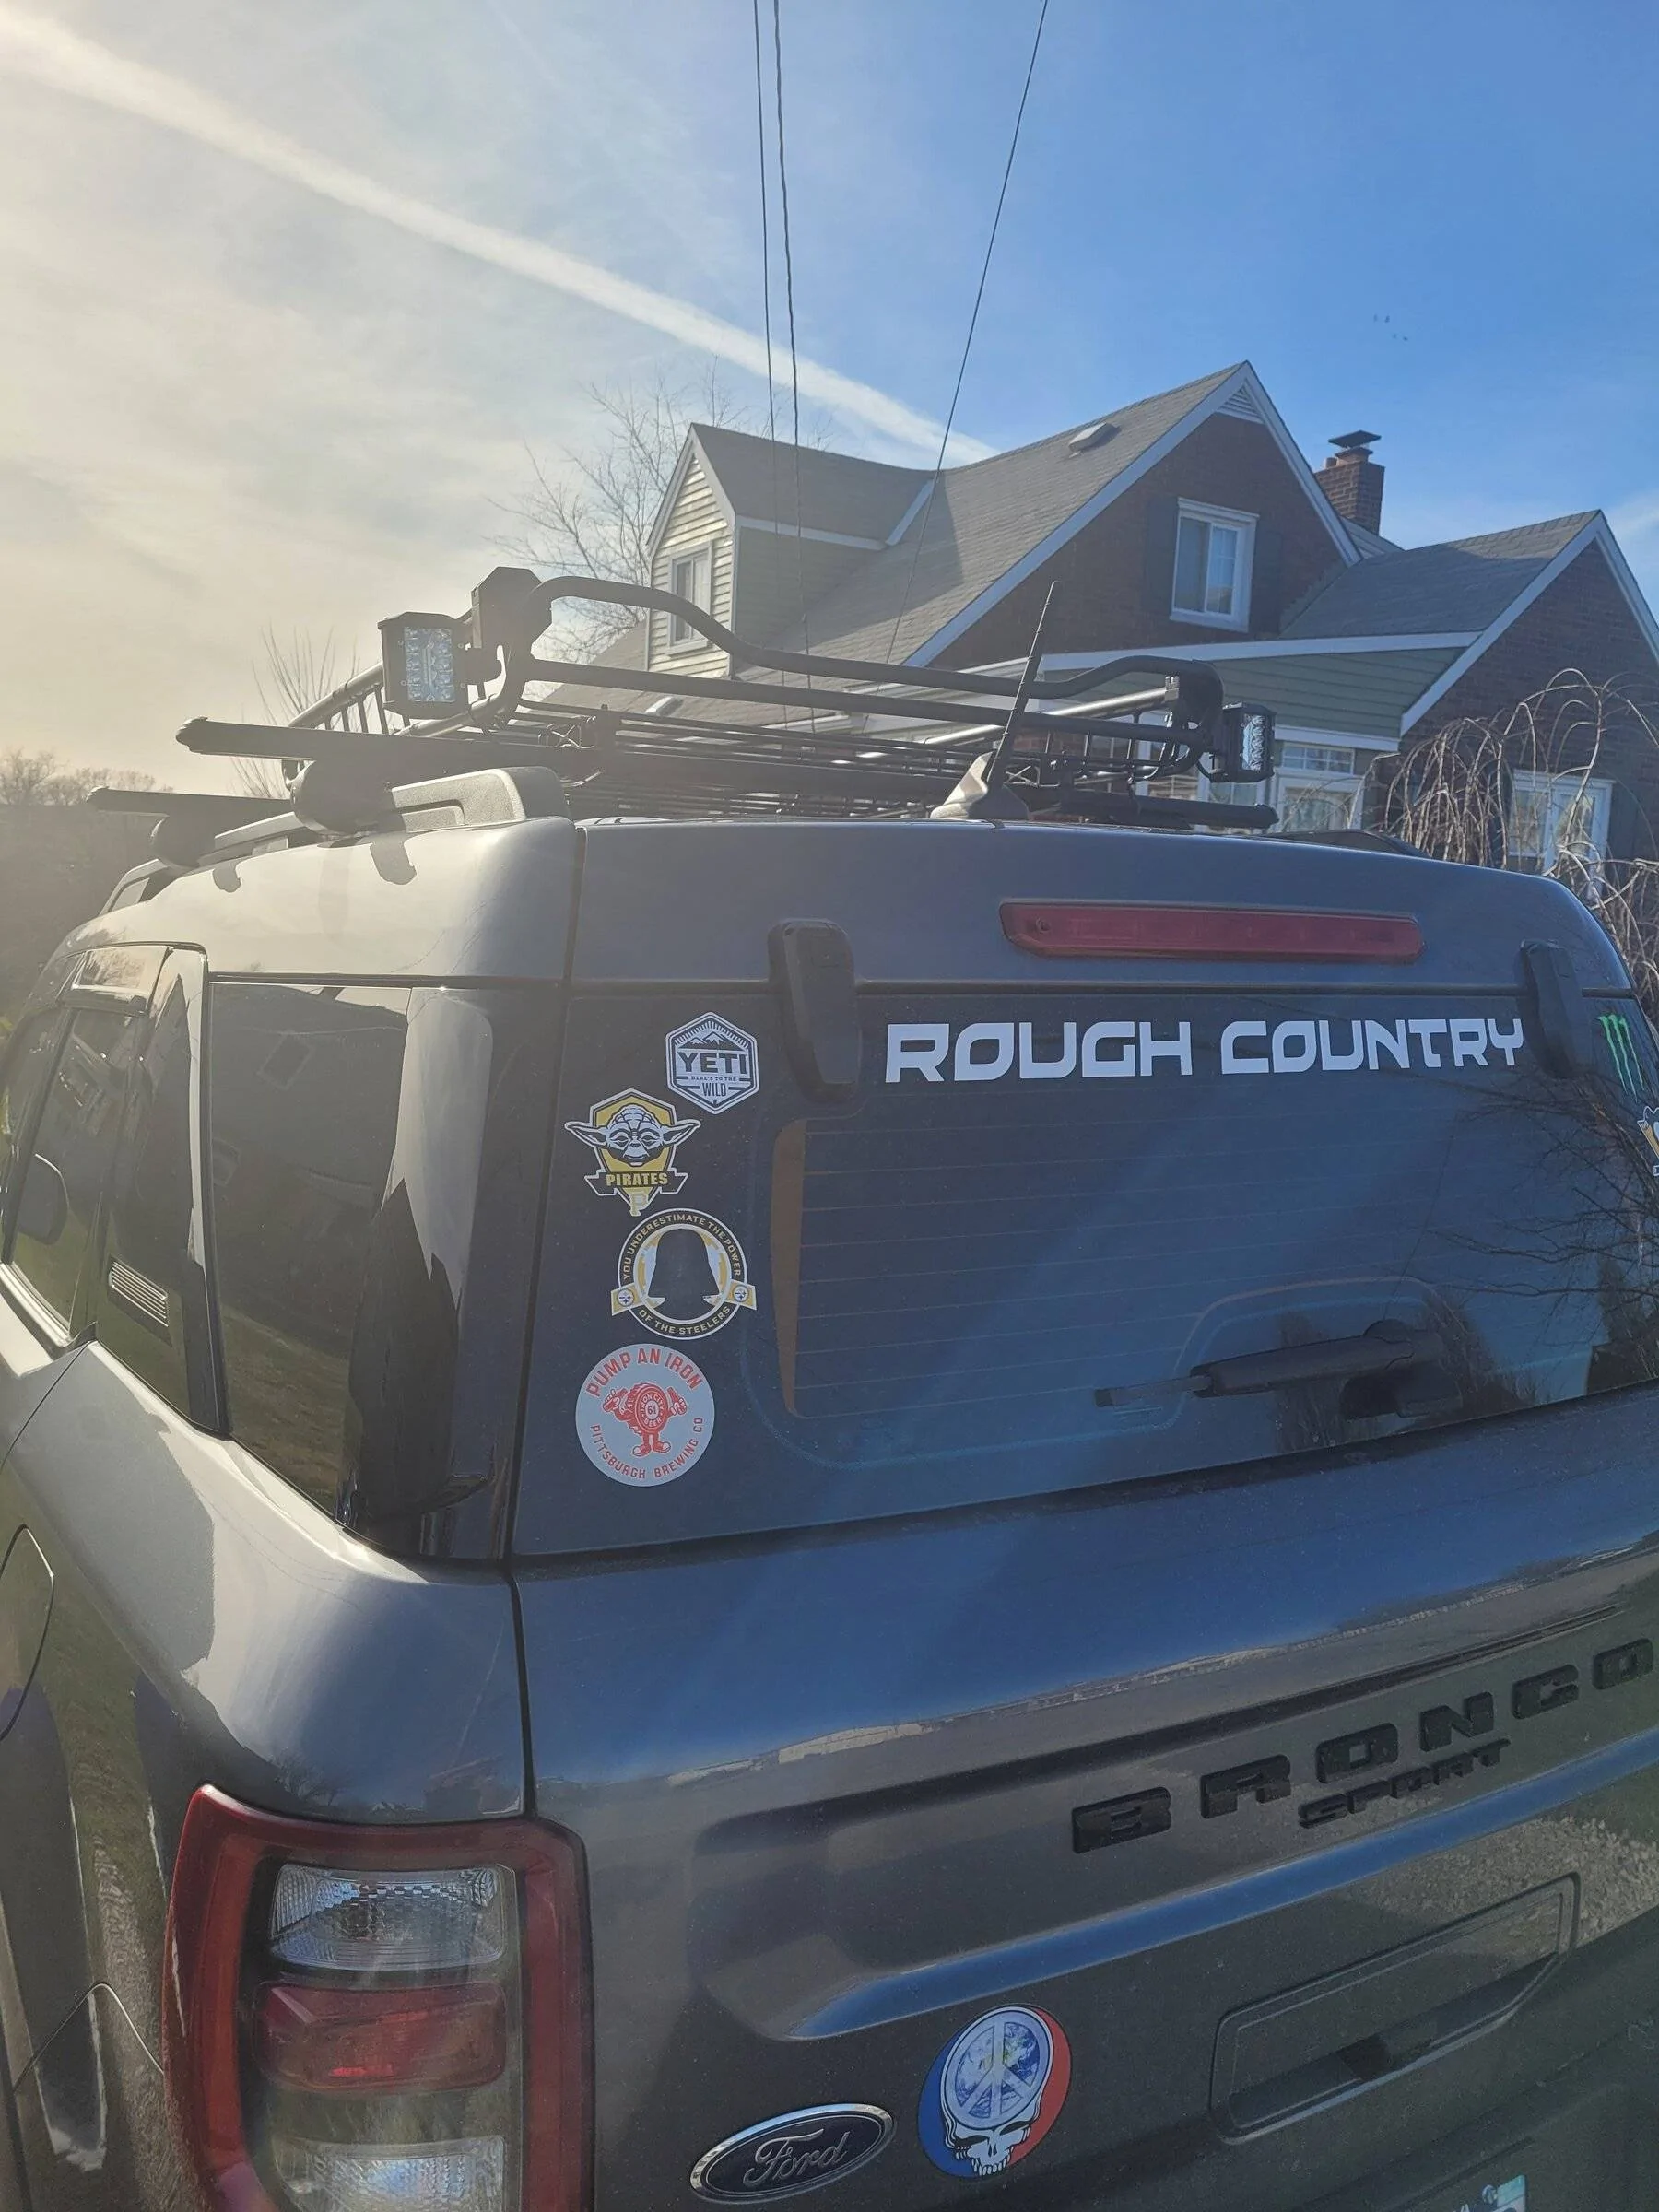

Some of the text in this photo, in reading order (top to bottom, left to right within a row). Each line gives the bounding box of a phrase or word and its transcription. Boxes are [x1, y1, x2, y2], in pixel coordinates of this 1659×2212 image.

[677, 1051, 748, 1075] YETI
[885, 1018, 1524, 1083] ROUGH COUNTRY
[702, 1082, 727, 1097] WILD
[606, 1171, 668, 1187] PIRATES
[622, 1213, 742, 1281] YOU UNDERESTIMATE THE POWER
[638, 1305, 731, 1335] OF THE STEELERS
[585, 1347, 703, 1397] PUMP AN IRON
[647, 1406, 657, 1415] 61
[591, 1424, 646, 1479] PITTSBURGH
[653, 1438, 700, 1478] BREWING
[1070, 1636, 1654, 1854] BRONCO
[1297, 1737, 1512, 1829] SPORT
[742, 2127, 851, 2187] Ford
